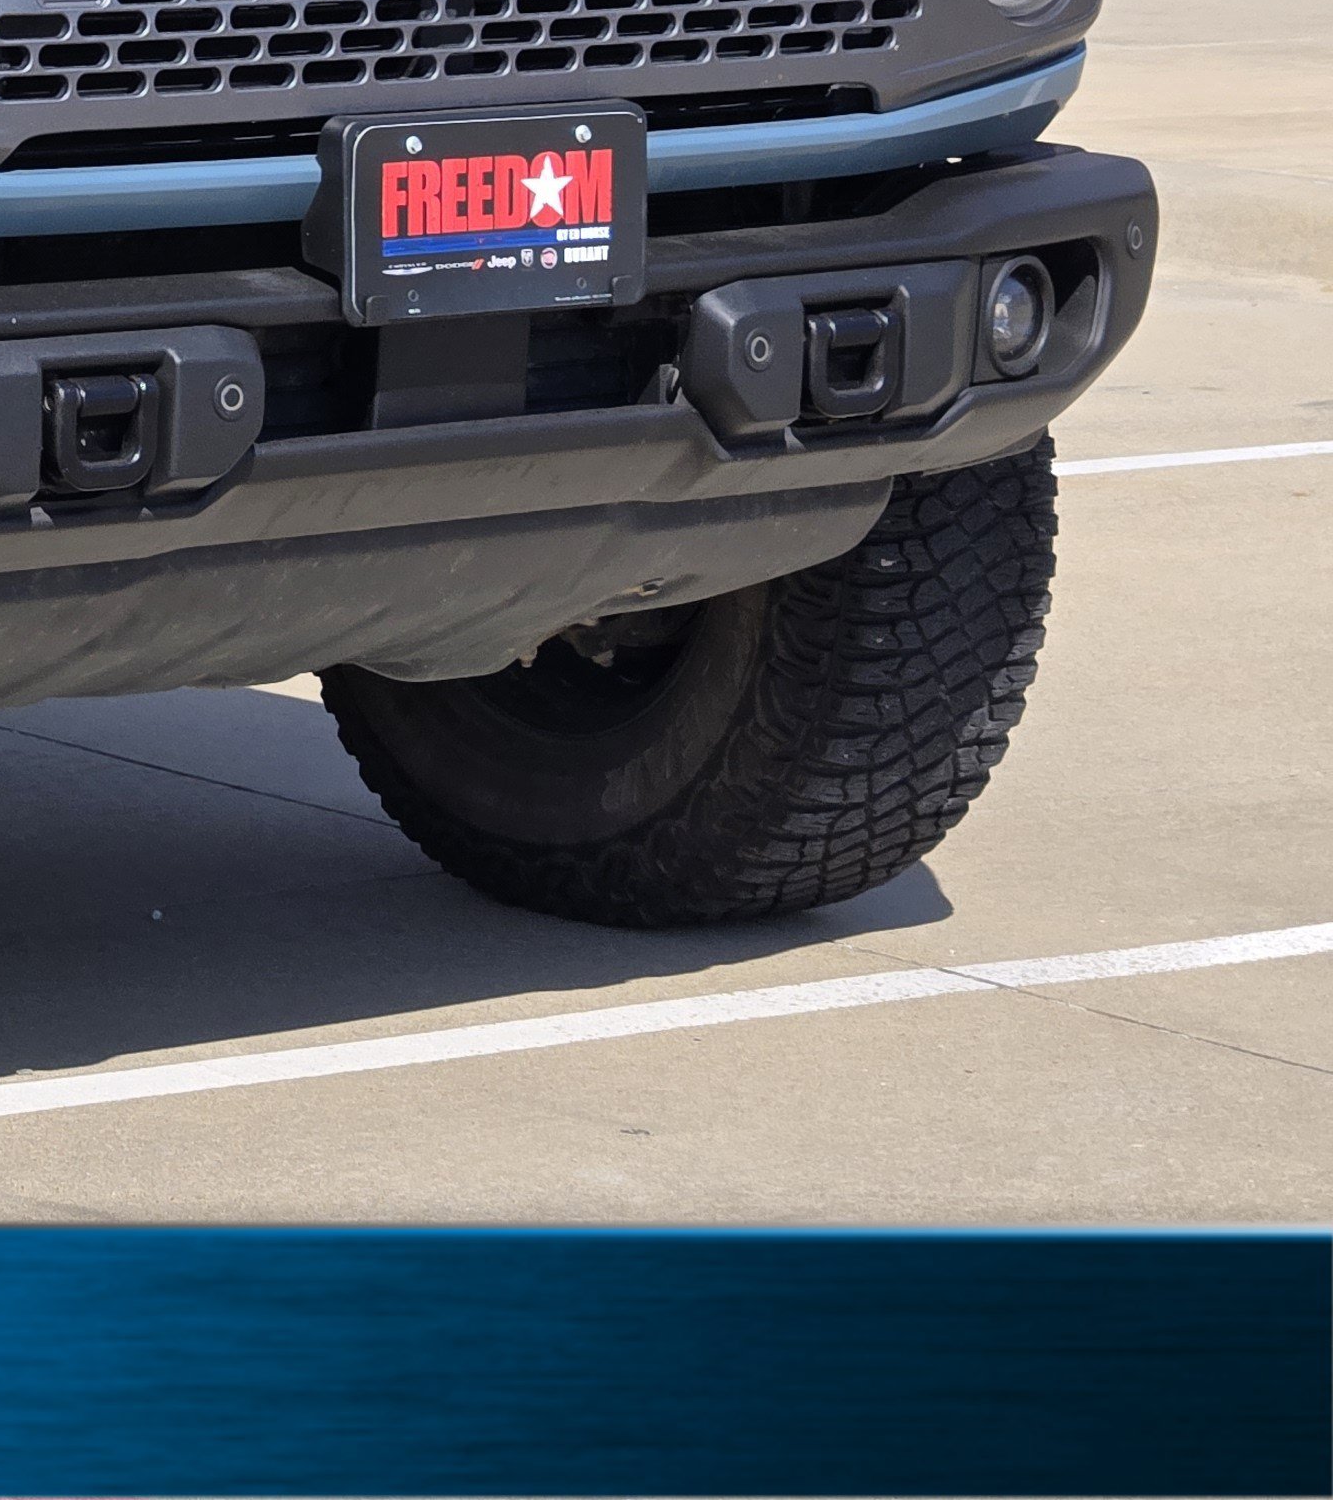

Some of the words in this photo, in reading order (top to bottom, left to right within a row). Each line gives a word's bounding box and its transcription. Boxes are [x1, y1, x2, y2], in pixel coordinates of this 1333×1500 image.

[381, 149, 613, 238] FREEDOM
[487, 255, 517, 269] Jeep
[564, 245, 609, 263] DURANT
